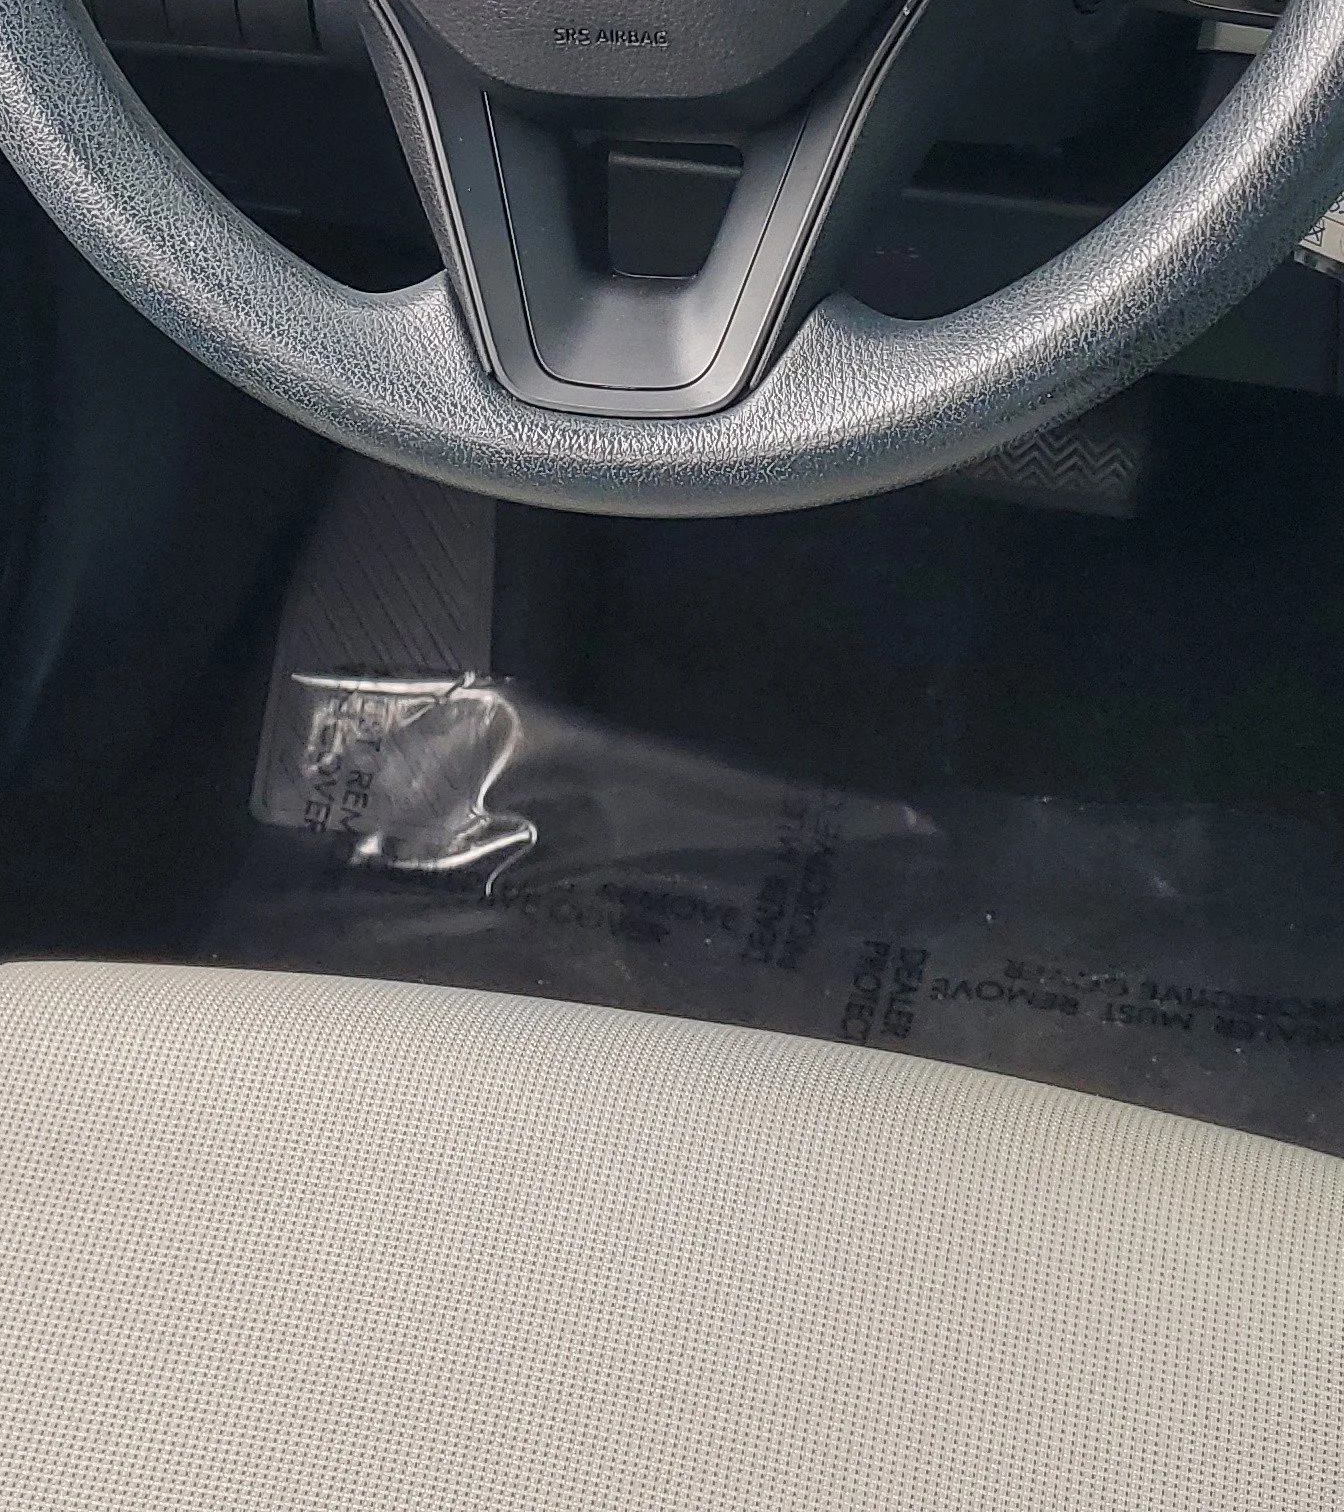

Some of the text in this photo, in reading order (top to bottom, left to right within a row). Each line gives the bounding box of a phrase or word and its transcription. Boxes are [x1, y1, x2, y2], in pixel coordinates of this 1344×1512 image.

[554, 27, 670, 48] SRS AIRBAG
[881, 946, 932, 1040] DEALER
